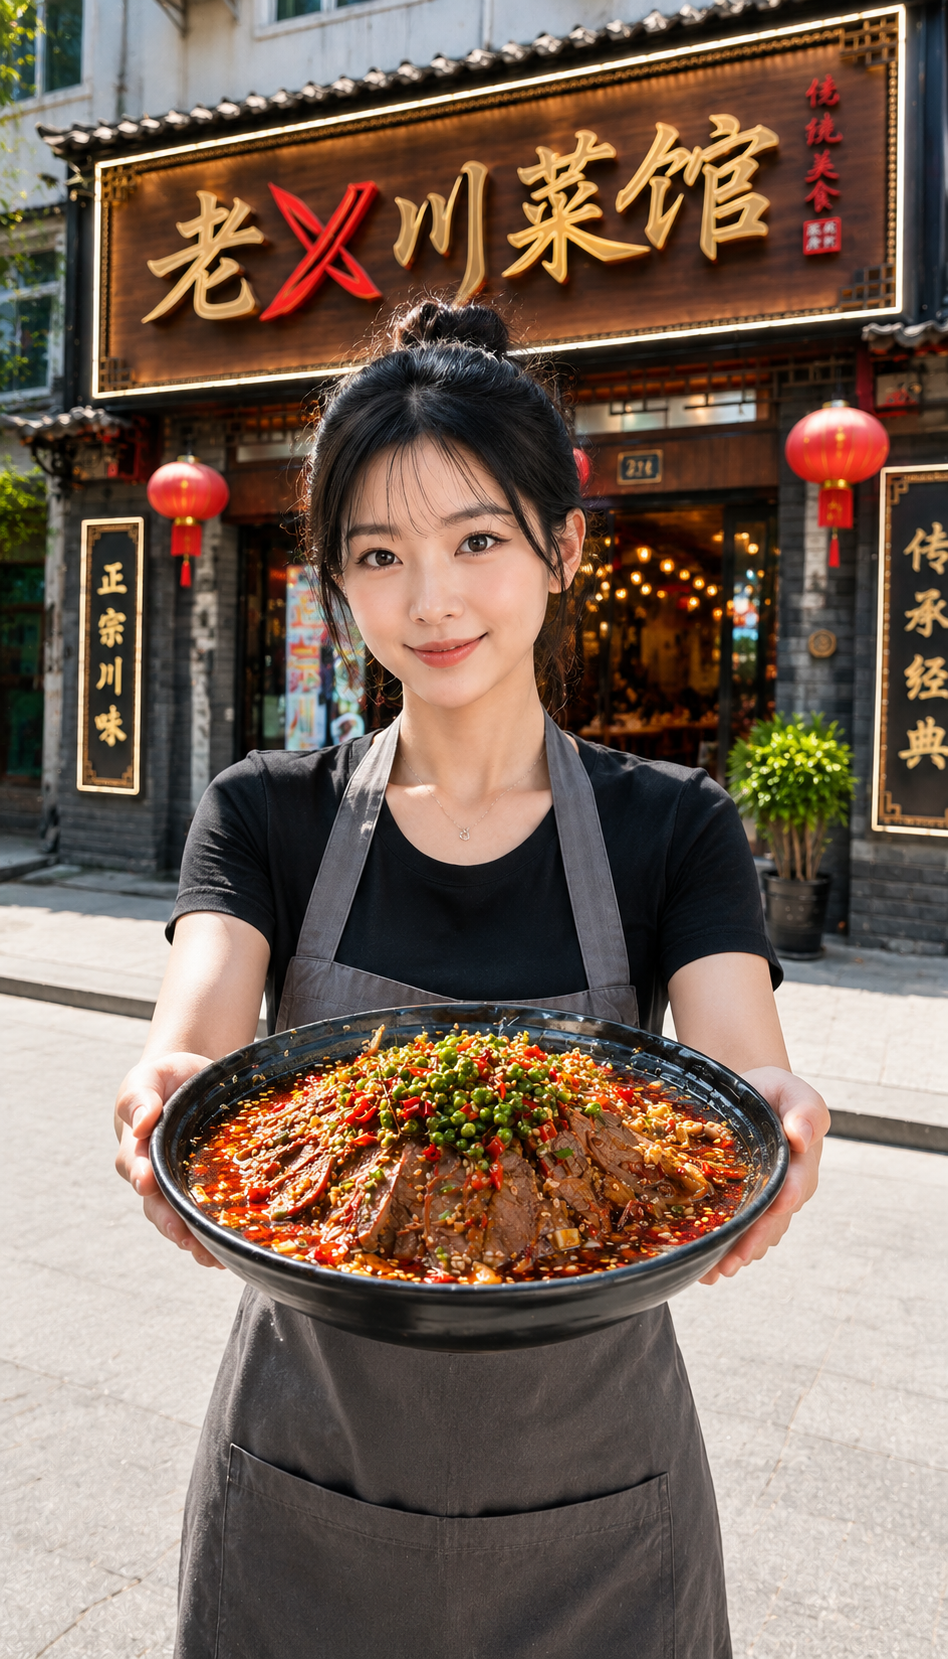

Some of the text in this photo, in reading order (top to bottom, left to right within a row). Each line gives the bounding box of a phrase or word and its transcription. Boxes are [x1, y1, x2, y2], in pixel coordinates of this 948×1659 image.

[94, 561, 128, 747] 正宗川味
[899, 521, 948, 770] 传承经典
